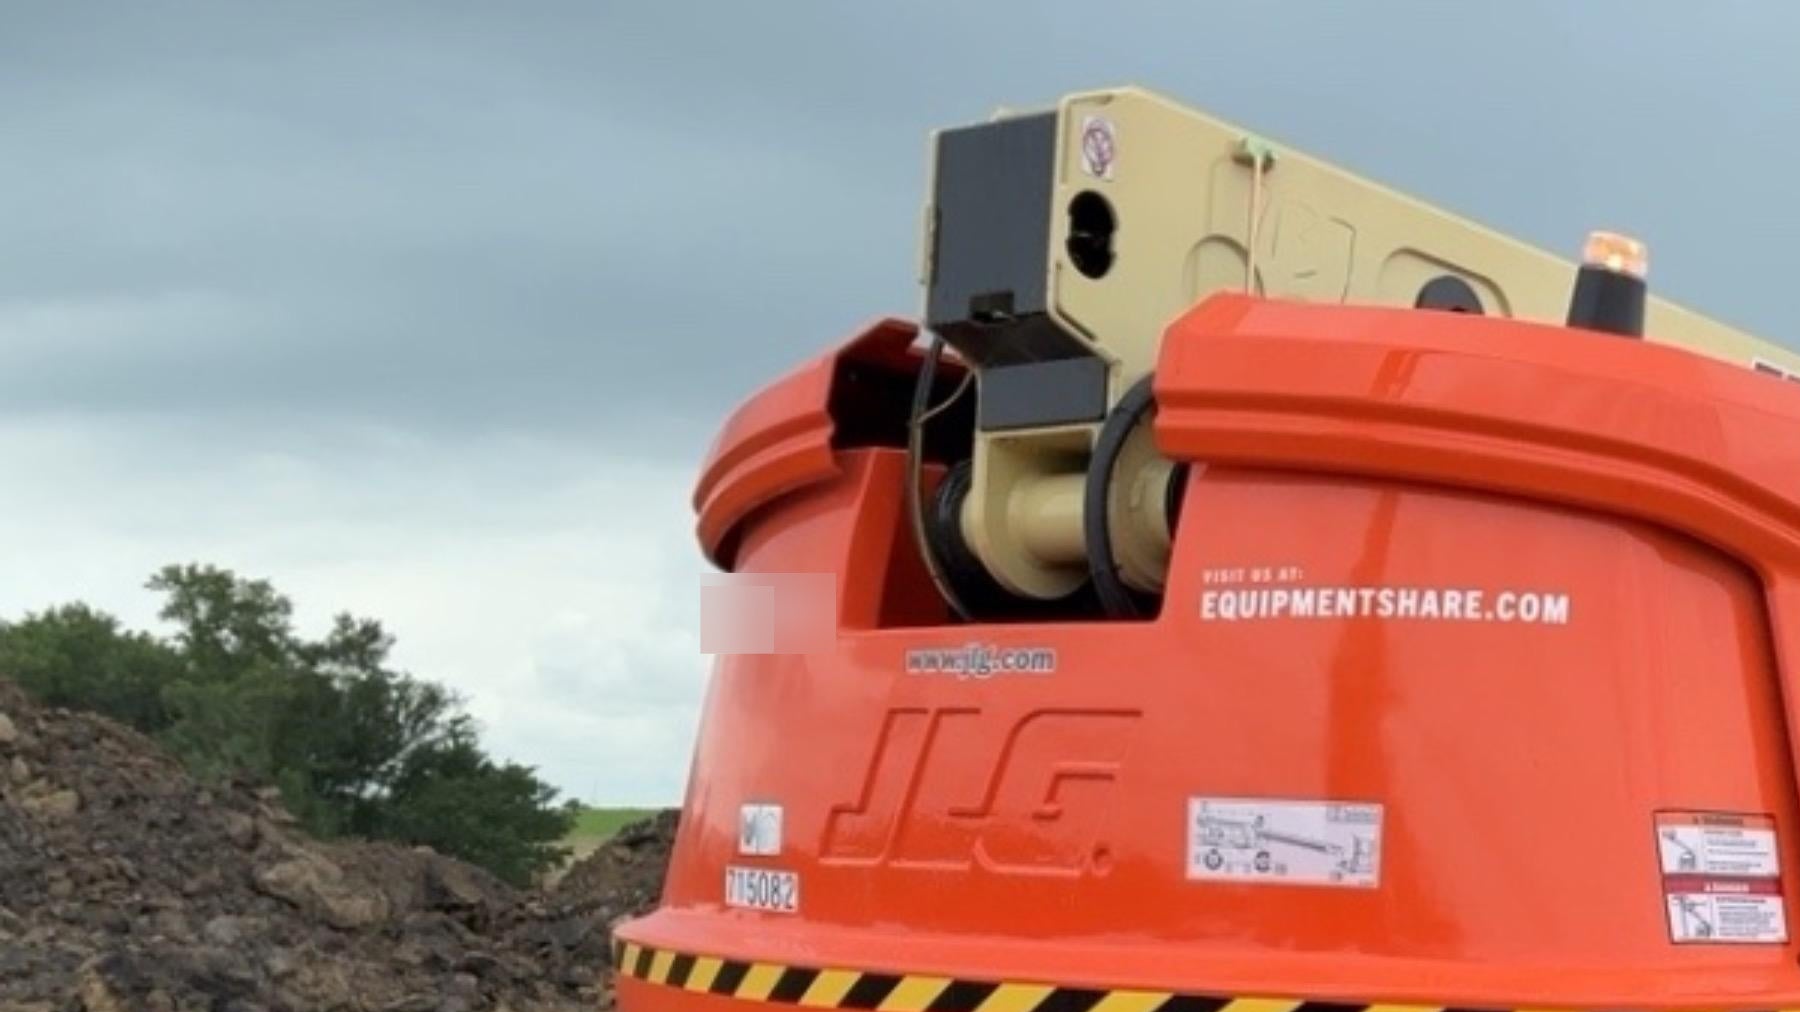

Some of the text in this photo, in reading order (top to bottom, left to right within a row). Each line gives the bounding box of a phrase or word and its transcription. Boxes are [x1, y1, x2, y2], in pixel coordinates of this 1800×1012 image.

[1201, 588, 1571, 625] EQUIPMENTSHARE.COM
[905, 642, 1058, 680] www.jlg.com
[727, 869, 797, 910] 715082
